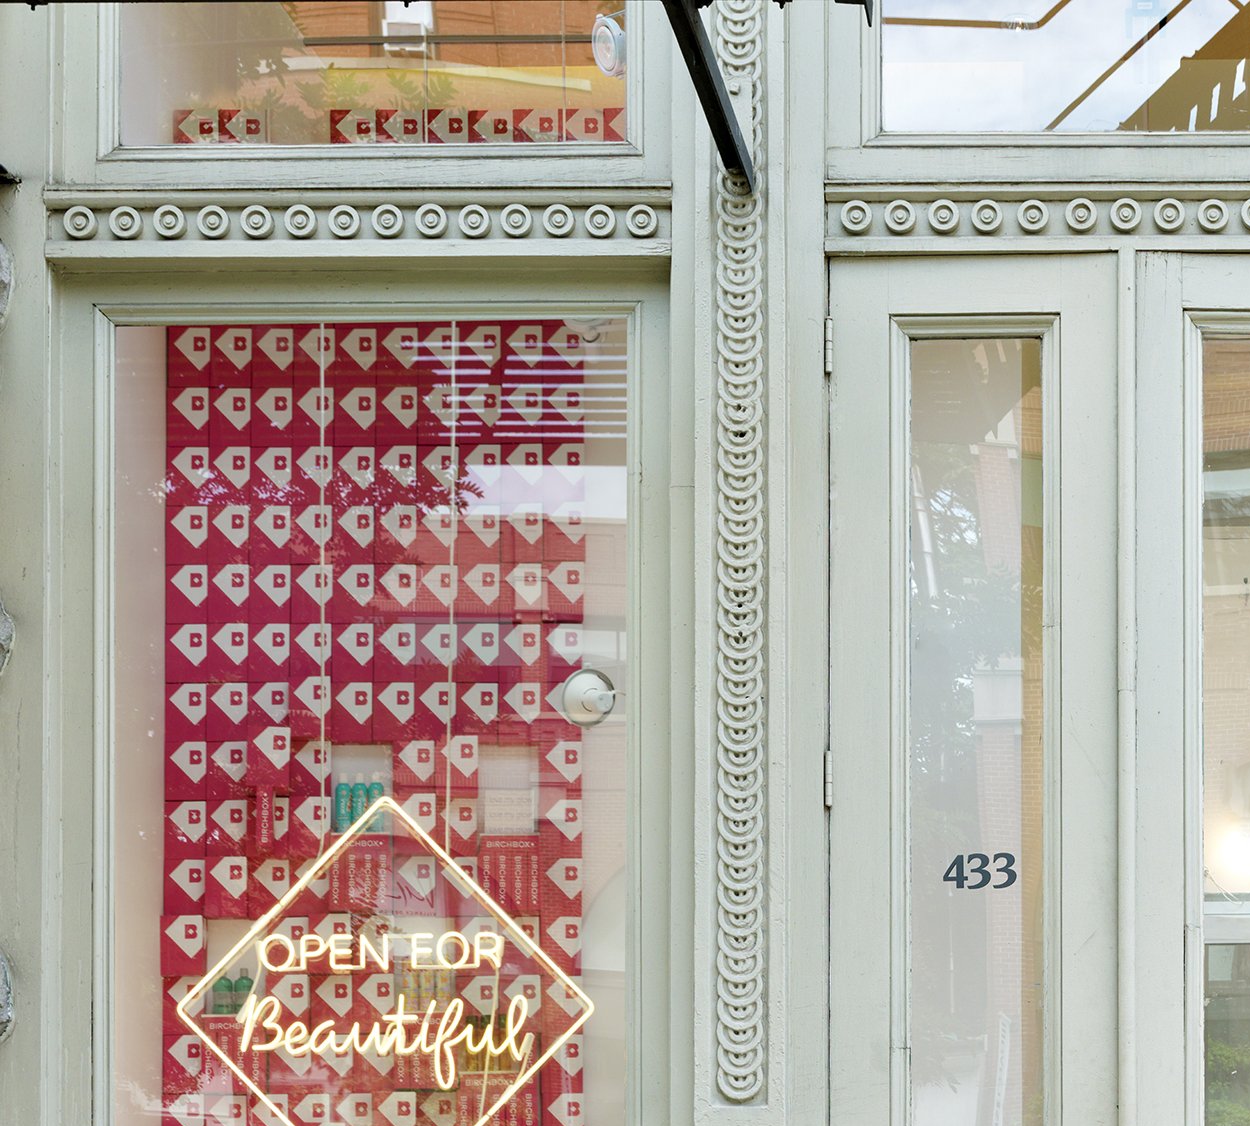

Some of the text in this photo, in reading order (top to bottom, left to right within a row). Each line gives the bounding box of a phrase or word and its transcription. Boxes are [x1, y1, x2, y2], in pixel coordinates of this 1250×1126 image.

[261, 797, 269, 843] BIRCHBOX
[486, 840, 531, 848] BIRCHBOX
[482, 855, 490, 893] BIRCHBO
[942, 852, 1018, 890] 433
[259, 932, 503, 971] OPEN FOR
[239, 994, 530, 1090] Beautiful
